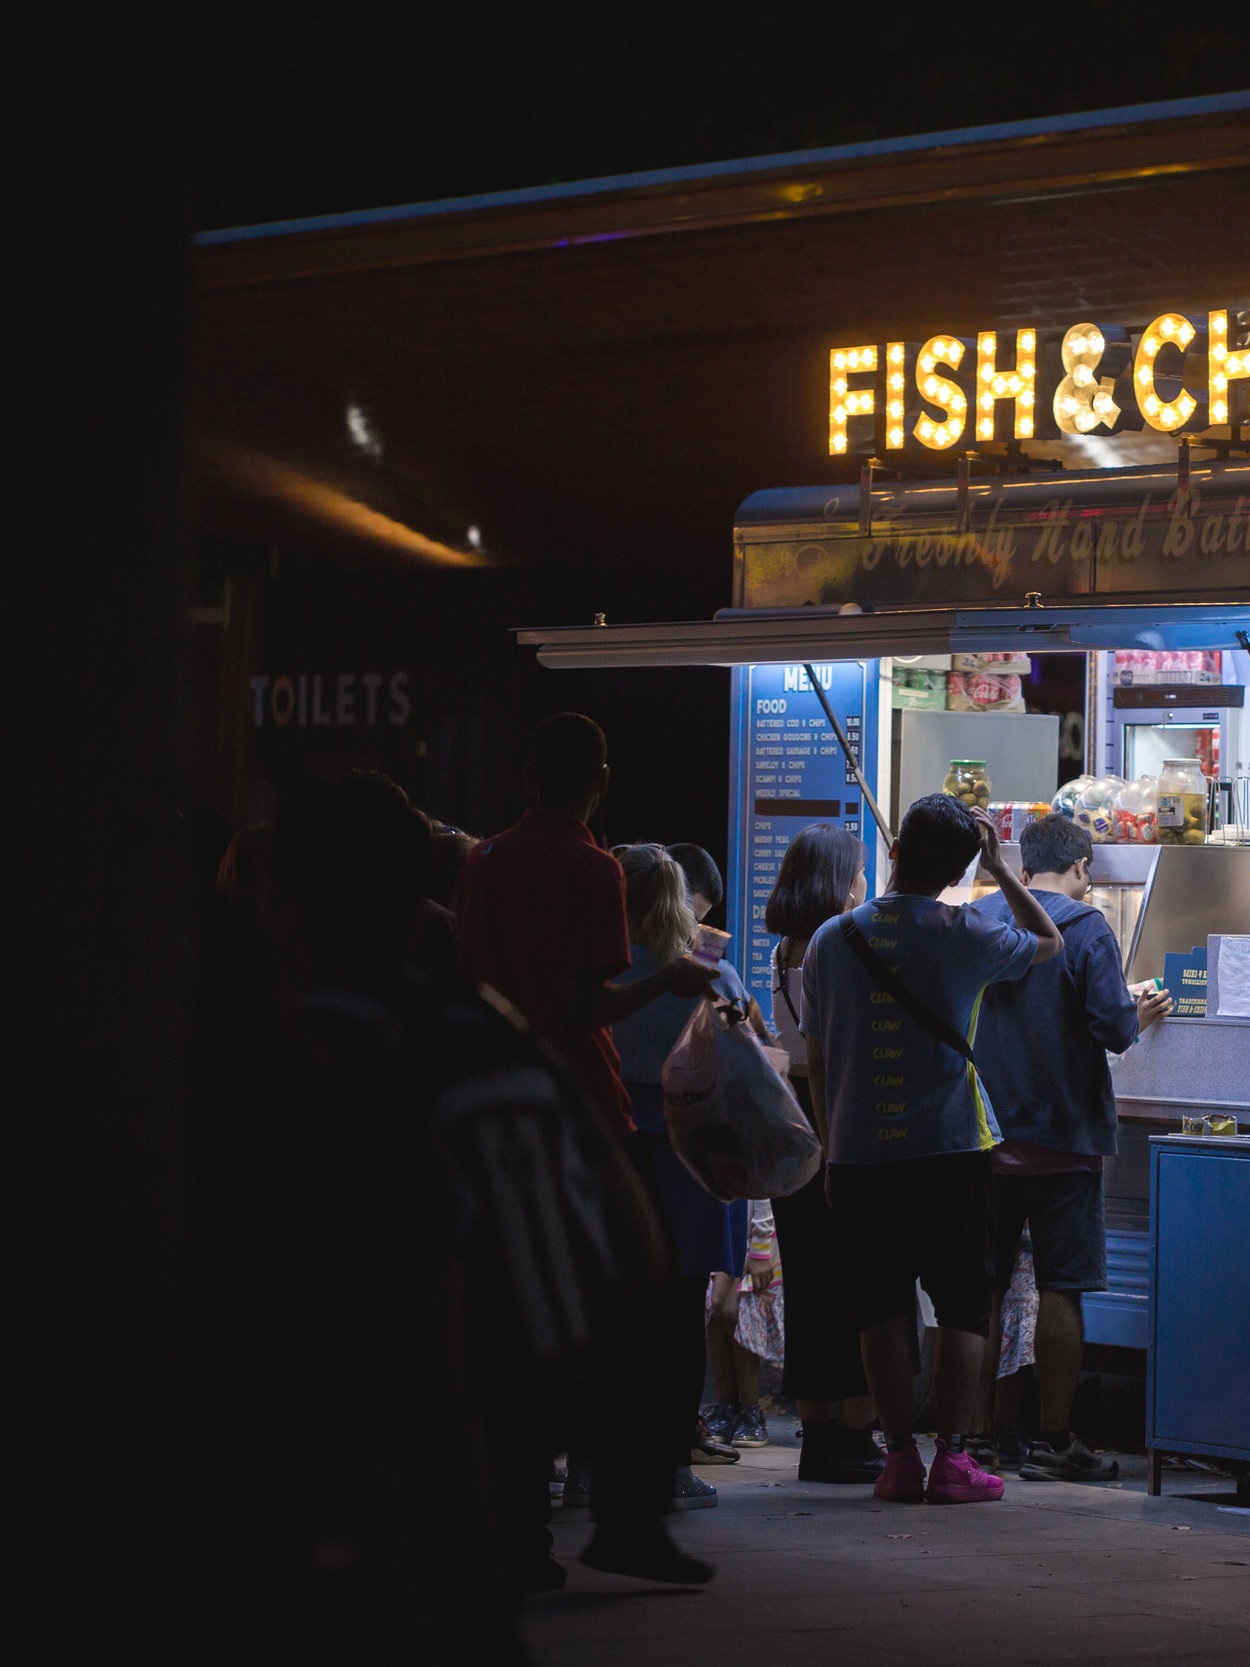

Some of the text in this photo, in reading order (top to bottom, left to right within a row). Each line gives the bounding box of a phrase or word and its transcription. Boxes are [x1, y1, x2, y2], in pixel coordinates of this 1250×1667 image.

[828, 328, 1036, 455] FISH
[1053, 322, 1121, 435] &
[1031, 493, 1152, 559] Hand
[250, 671, 411, 728] TOILETS
[756, 699, 787, 714] FOOD
[871, 912, 900, 924] CLAW
[868, 937, 898, 949] CLAW
[870, 992, 896, 1004] CLA
[872, 1020, 902, 1031] CLAW
[872, 1048, 903, 1059] CLAW
[874, 1076, 904, 1087] CLAW
[876, 1103, 905, 1114] CLAW
[878, 1129, 908, 1140] CLAW
